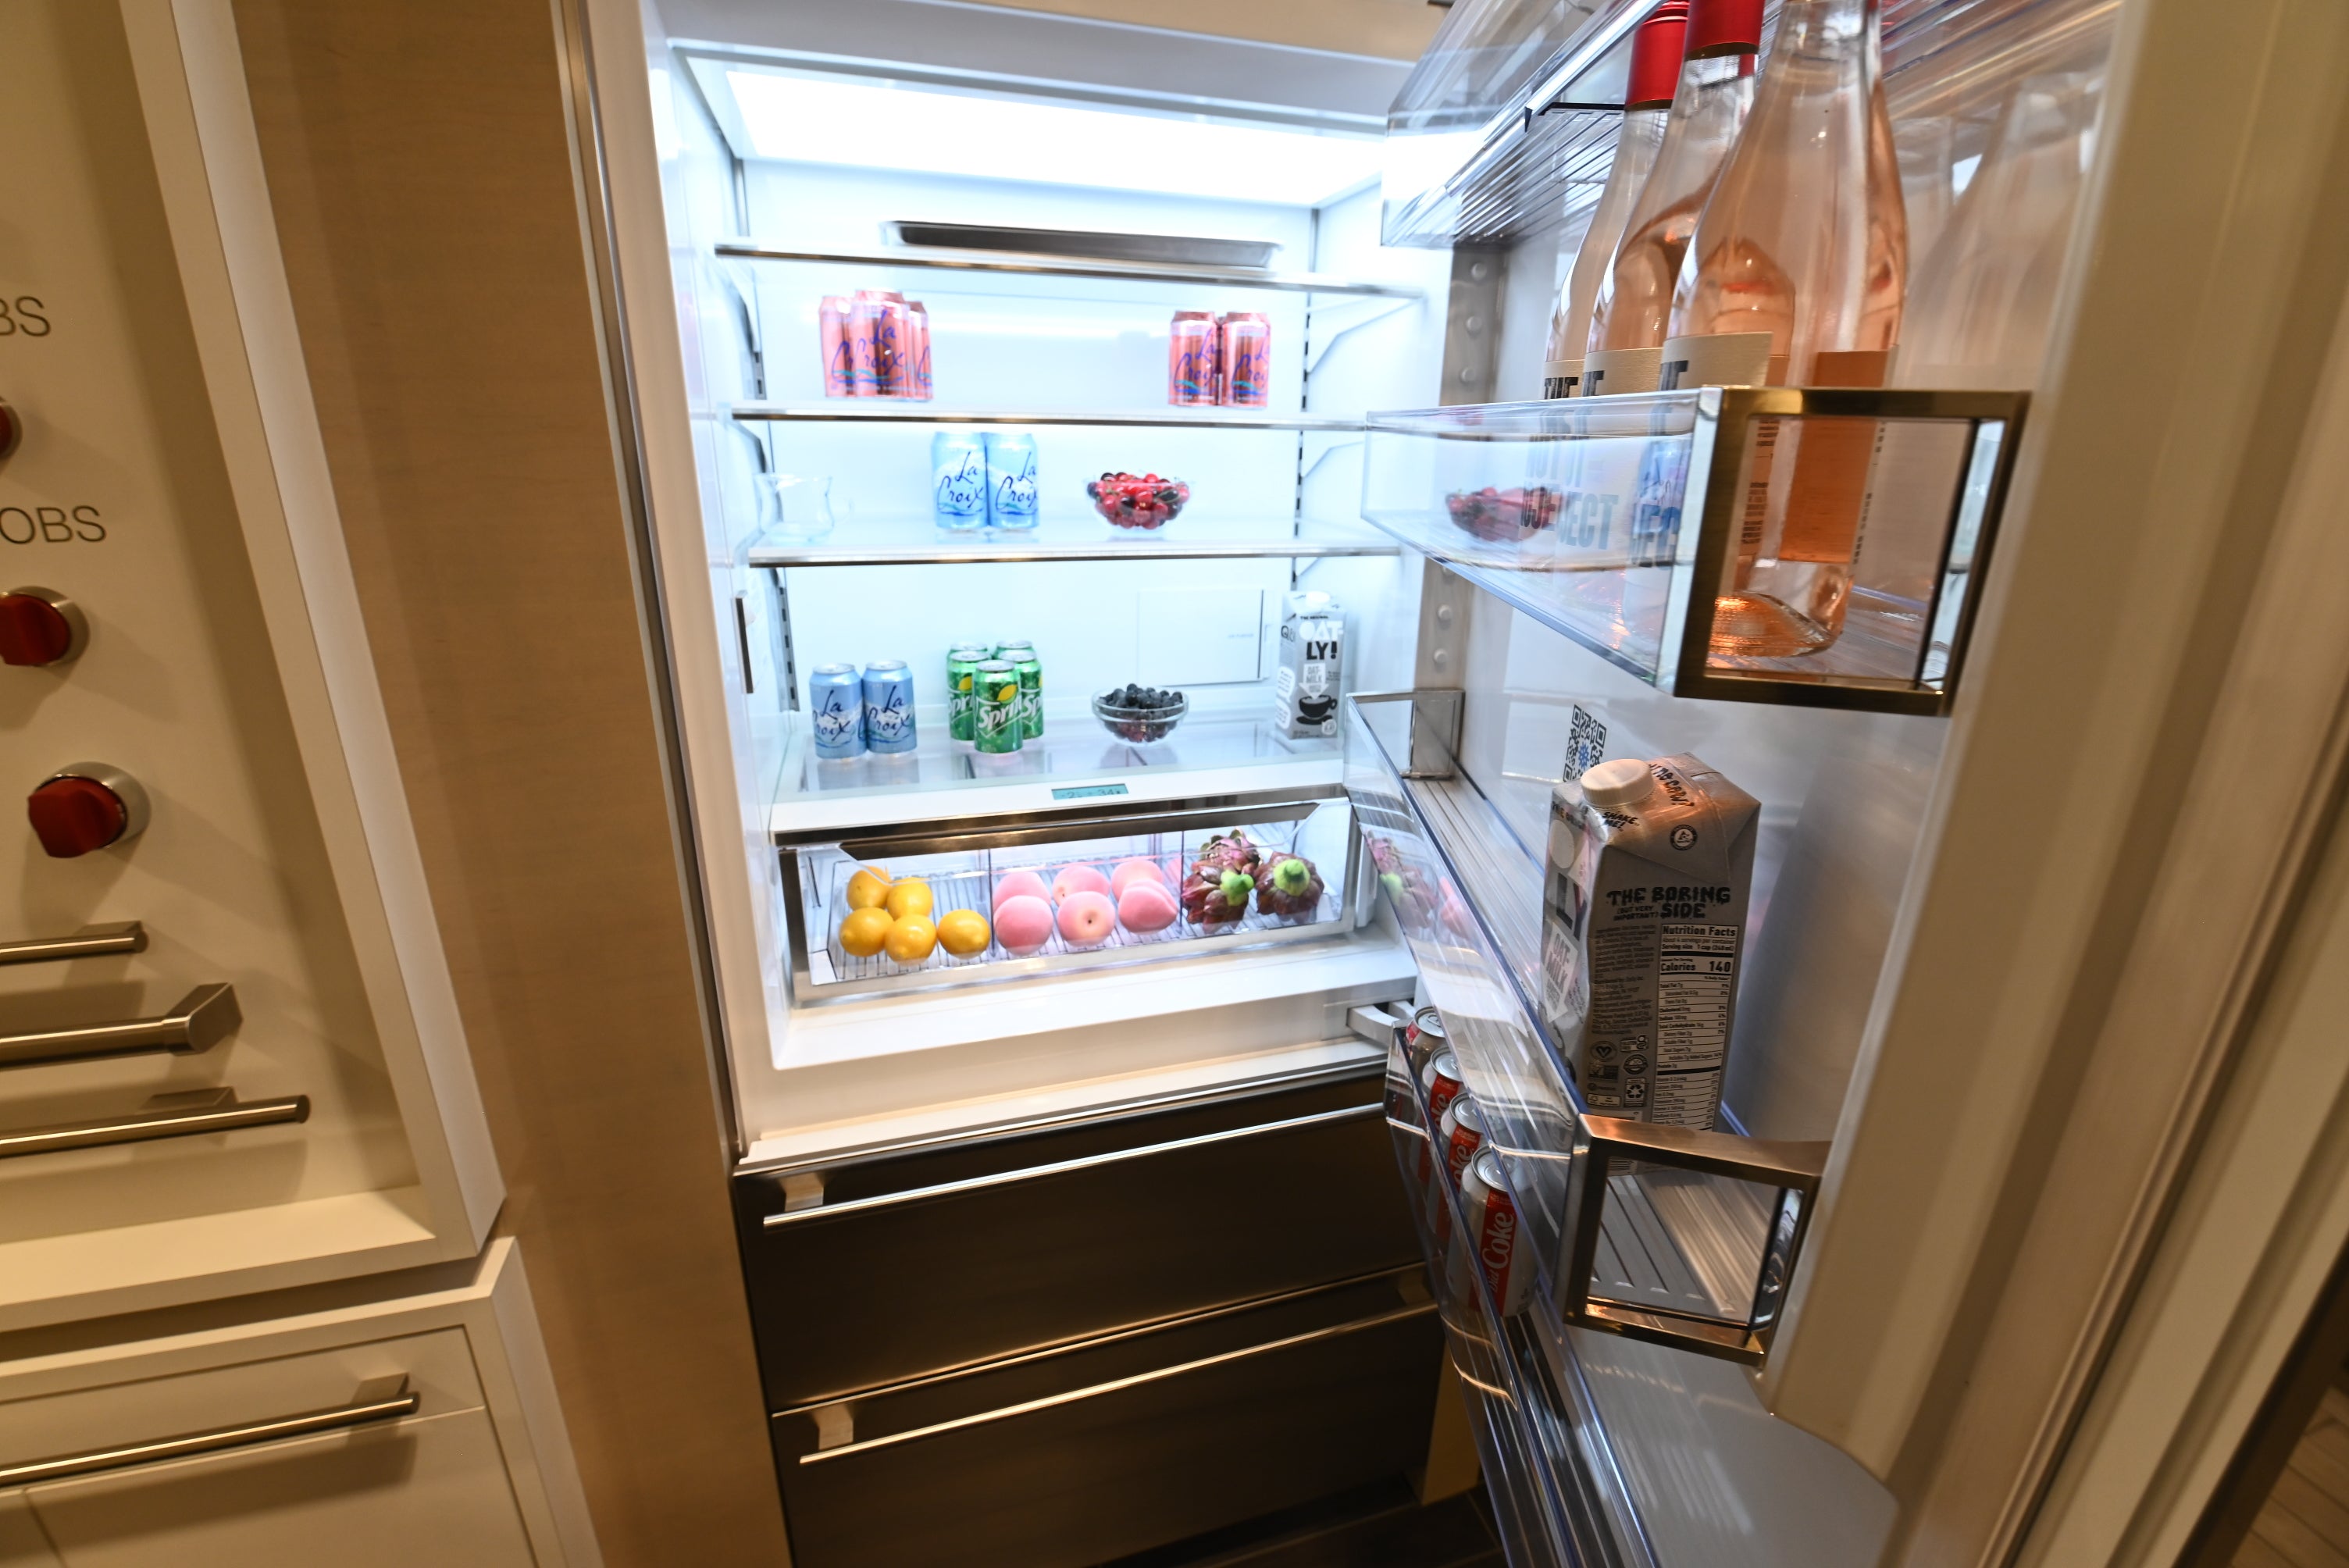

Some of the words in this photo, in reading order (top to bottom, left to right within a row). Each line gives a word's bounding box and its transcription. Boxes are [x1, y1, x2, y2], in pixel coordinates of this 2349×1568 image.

[870, 309, 896, 348] La
[955, 451, 978, 484] La
[1018, 451, 1035, 484] La
[937, 476, 984, 516] Croix
[1299, 621, 1343, 640] OAT-
[1306, 640, 1338, 660] LY!
[821, 690, 843, 721] La
[882, 686, 904, 715] La
[867, 707, 912, 743] Croix
[1602, 811, 1638, 825] SHAKE
[1607, 888, 1647, 906] THE
[1652, 887, 1731, 904] BORING
[1660, 903, 1706, 919] SIDE
[1663, 925, 1706, 935] Nutrition
[1709, 926, 1736, 936] Facts
[1661, 963, 1696, 971] Calories
[1709, 961, 1731, 972] 140
[1450, 1145, 1474, 1186] oke
[1481, 1212, 1514, 1270] Coke
